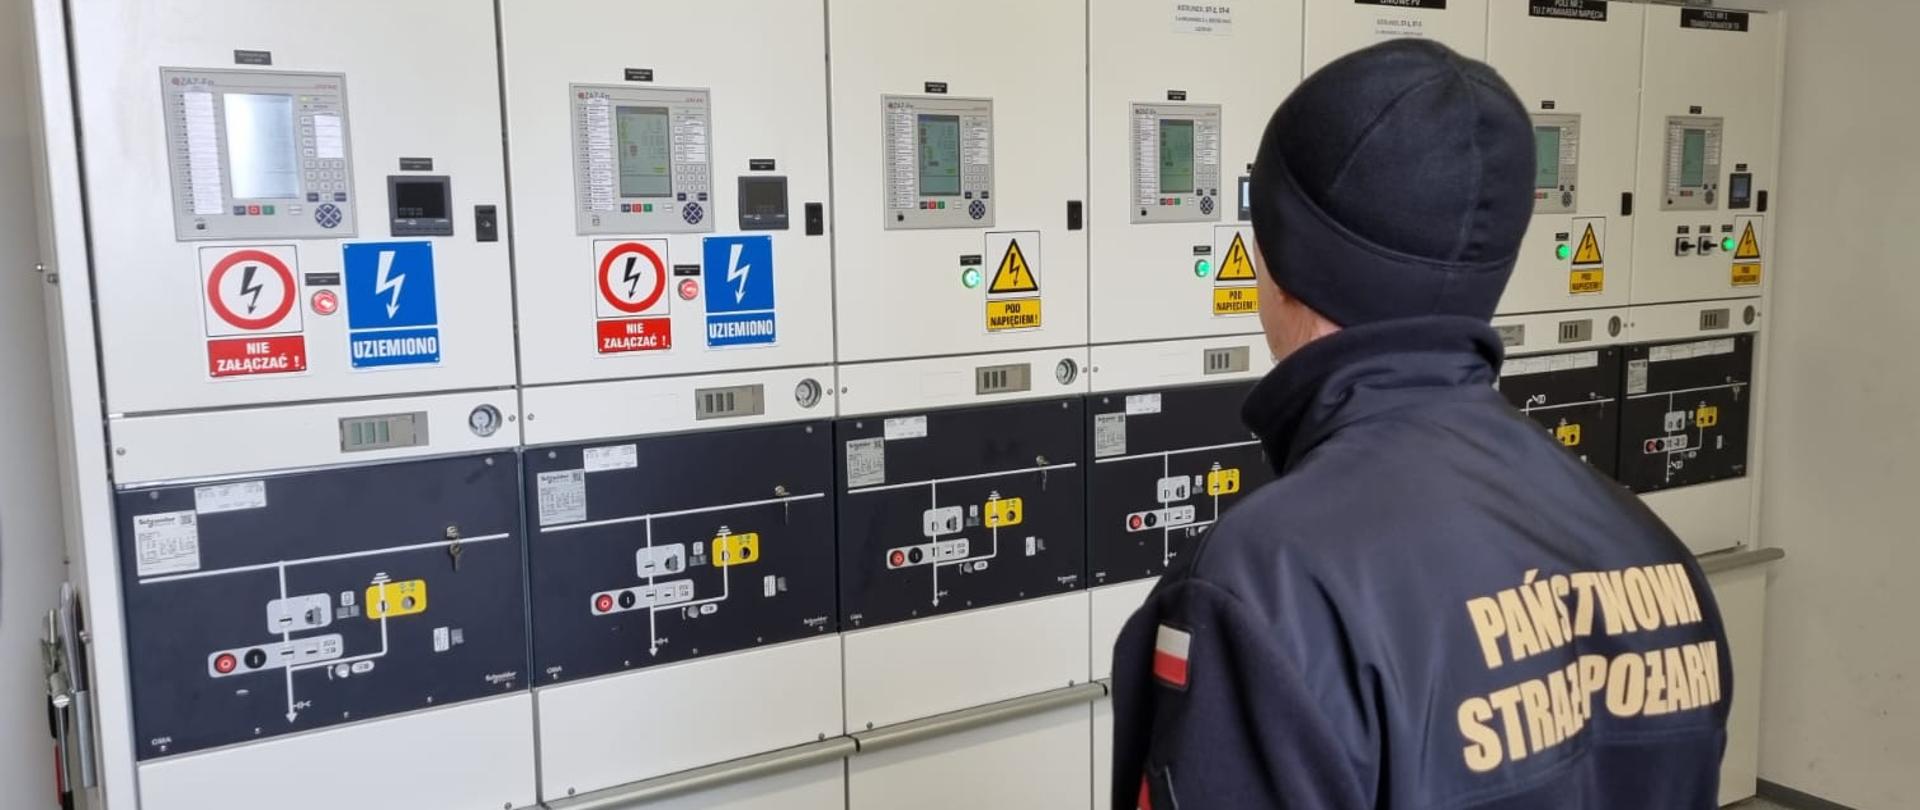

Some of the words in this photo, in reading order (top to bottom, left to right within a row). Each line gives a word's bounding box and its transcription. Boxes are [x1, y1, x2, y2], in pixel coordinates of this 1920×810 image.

[1005, 303, 1021, 314] POD
[990, 314, 1038, 328] NAPIĘCIEM!
[625, 323, 644, 334] NIE
[709, 319, 773, 339] UZIEMIONO
[246, 342, 271, 355] NIE
[353, 336, 437, 359] UZIEMIONO
[603, 335, 658, 349] ZAŁĄCZAĆ
[216, 353, 289, 373] ZAŁĄCZAĆ
[1466, 563, 1703, 670] PAŃSTWOWA
